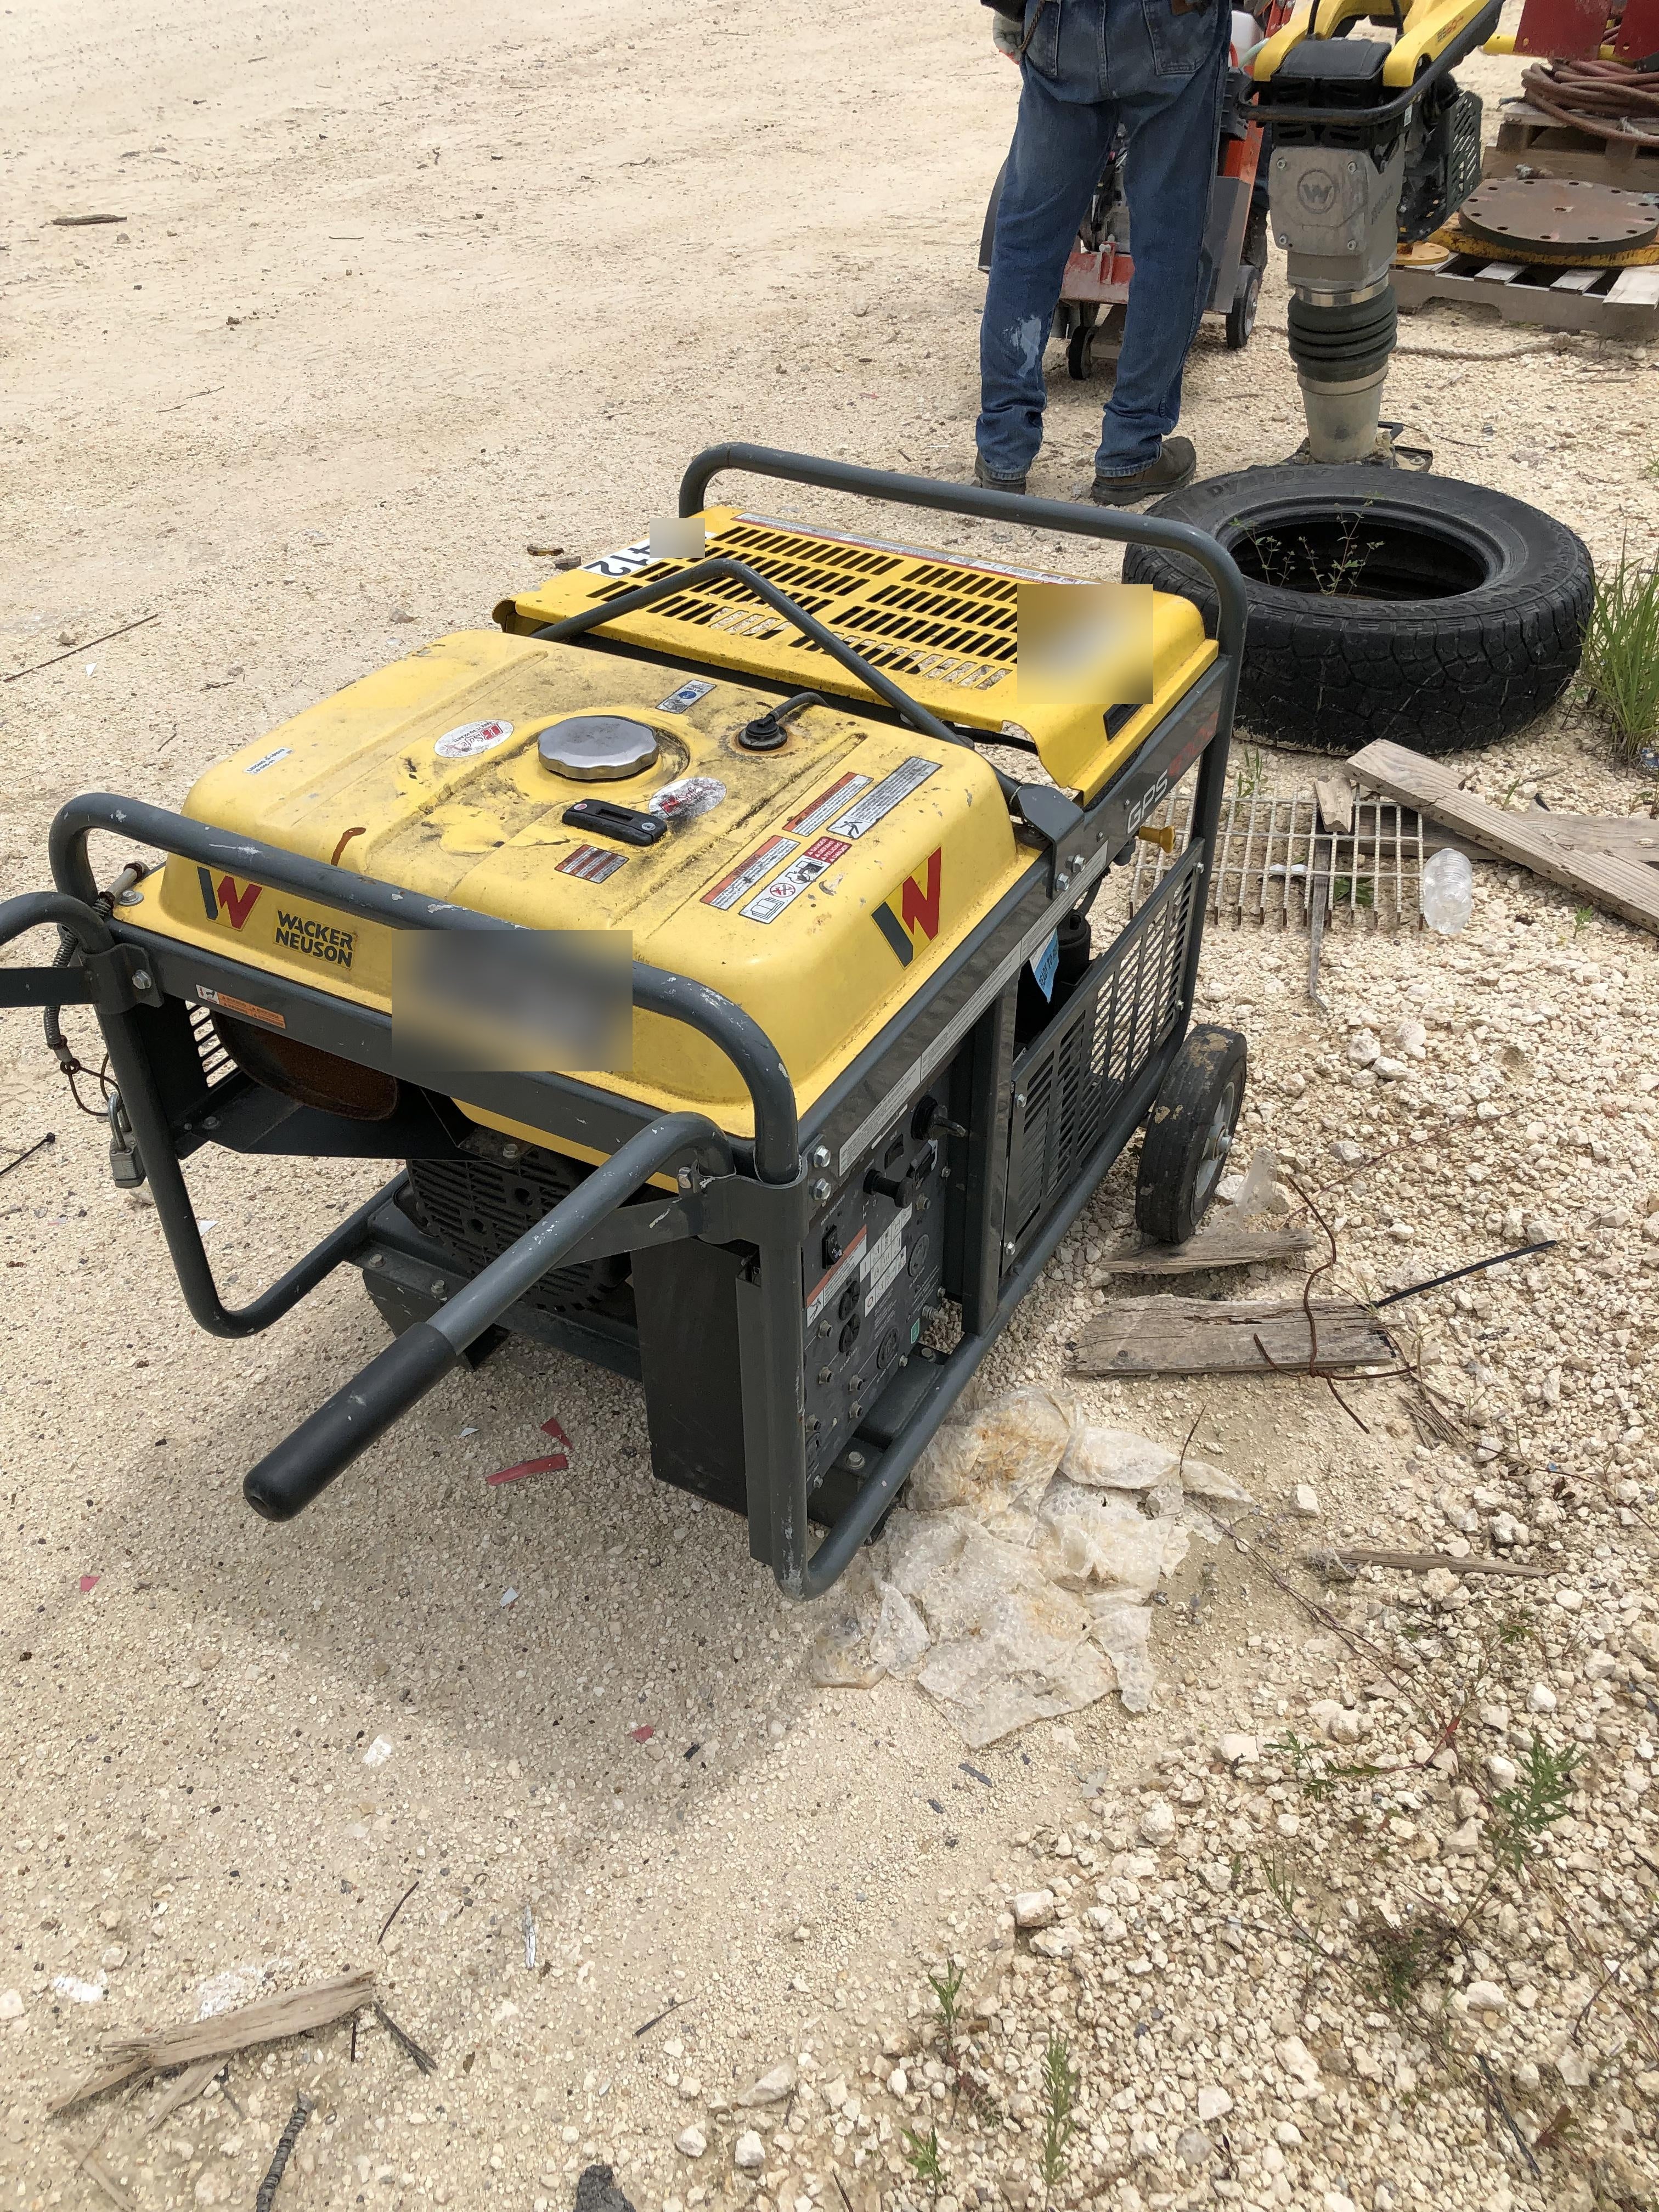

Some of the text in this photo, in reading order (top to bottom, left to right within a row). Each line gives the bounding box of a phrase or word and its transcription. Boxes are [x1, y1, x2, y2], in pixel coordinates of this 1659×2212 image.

[1127, 769, 1168, 834] GPS
[732, 854, 761, 877] WARNING
[275, 928, 353, 968] NEUSON
[277, 910, 353, 951] WACKER
